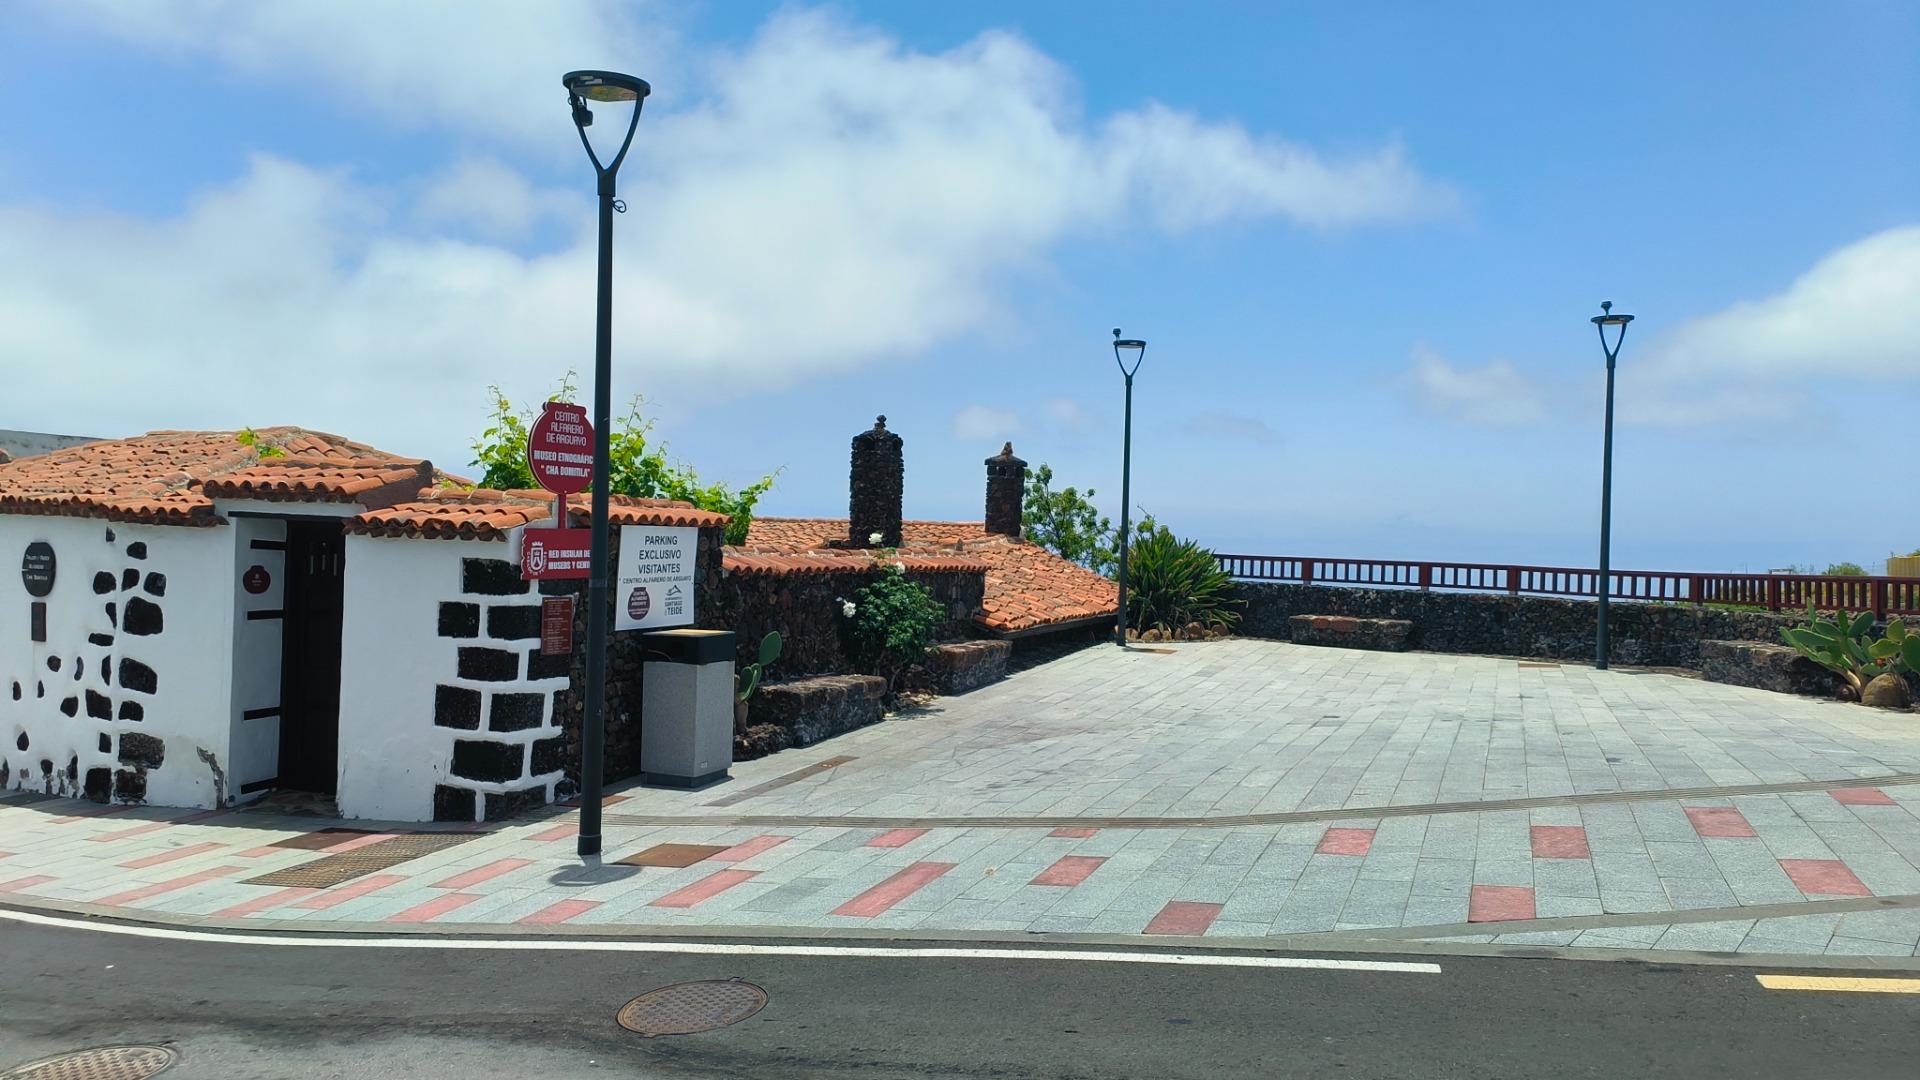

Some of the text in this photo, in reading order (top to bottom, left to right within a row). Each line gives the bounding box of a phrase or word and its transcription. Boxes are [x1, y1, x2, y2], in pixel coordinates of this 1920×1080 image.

[555, 411, 580, 423] CENTRO
[551, 421, 584, 435] ALFARERO
[546, 432, 587, 446] DE ARGUAYO
[533, 450, 594, 464] MUSEO ETNOGRÁFIC
[545, 465, 559, 475] CHA
[644, 535, 678, 546] PARKING
[548, 549, 591, 558] RED INSULAR DE
[639, 549, 682, 560] EXCLUSIVO
[548, 560, 591, 570] MUSEOS Y CENT
[638, 563, 681, 574] VISITANTES
[667, 606, 683, 616] TEIDE
